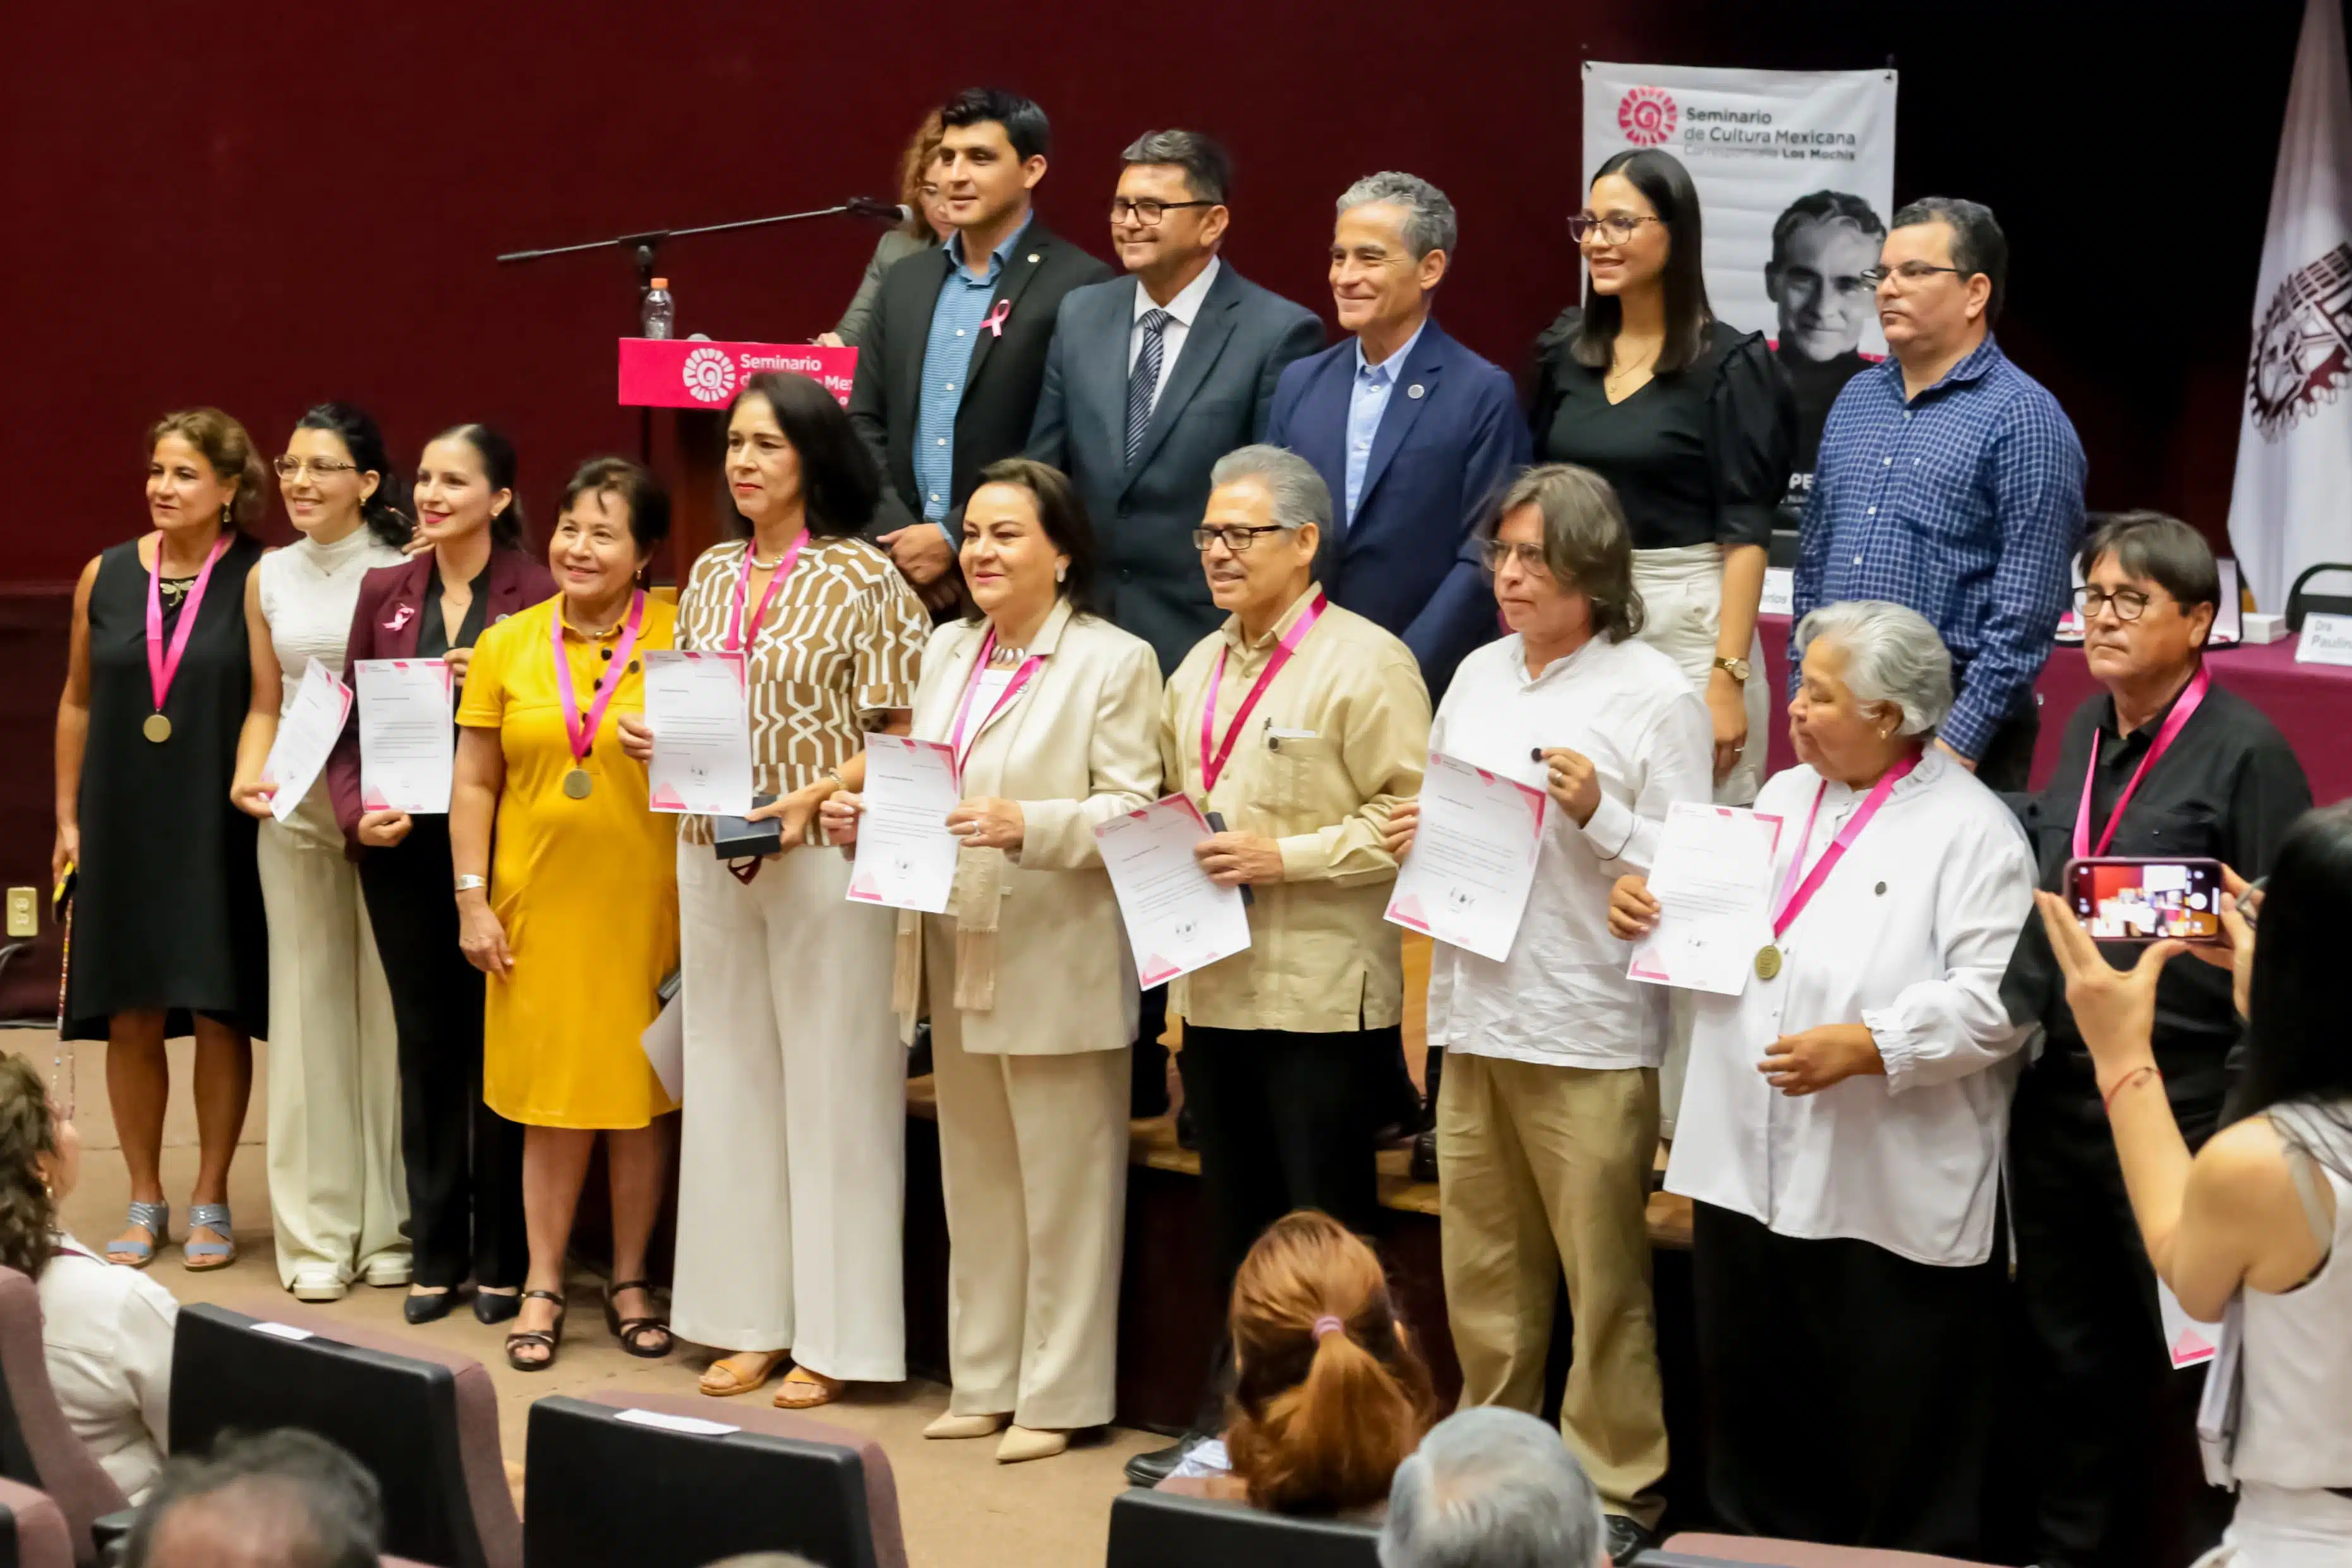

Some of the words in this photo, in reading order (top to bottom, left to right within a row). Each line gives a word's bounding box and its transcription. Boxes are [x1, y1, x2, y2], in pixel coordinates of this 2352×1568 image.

[1686, 107, 1773, 125] Seminario
[1684, 126, 1705, 141] de
[1709, 126, 1771, 144] Cultura
[1775, 128, 1856, 145] Mexicana
[1782, 147, 1806, 159] Los
[1809, 148, 1856, 160] Mochis
[740, 353, 823, 371] Seminario
[824, 375, 853, 391] Me
